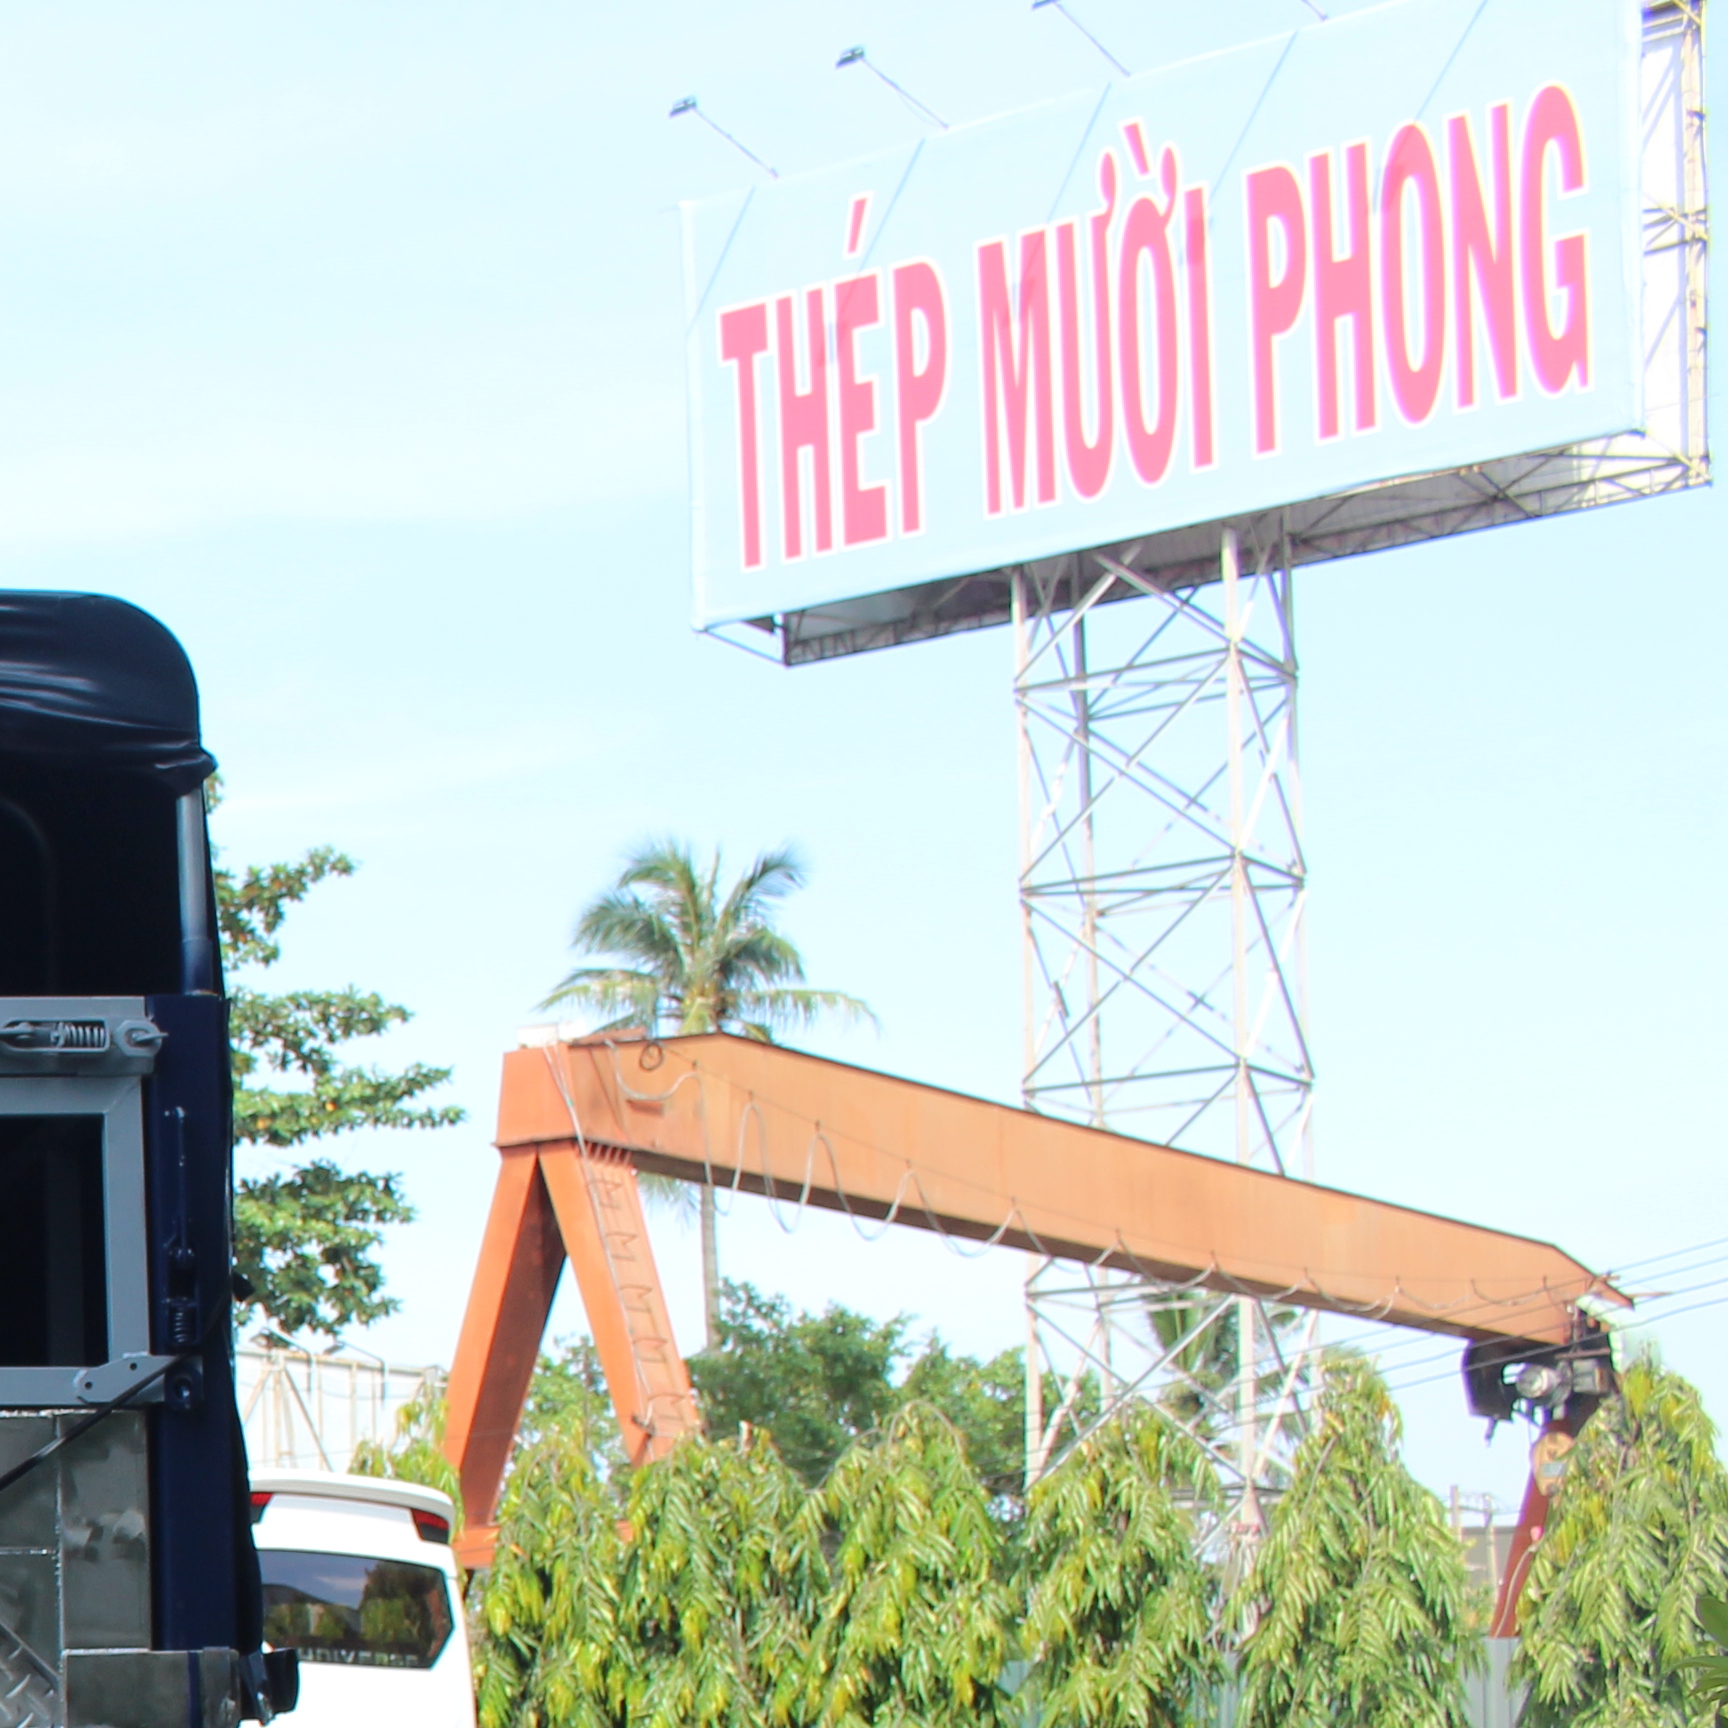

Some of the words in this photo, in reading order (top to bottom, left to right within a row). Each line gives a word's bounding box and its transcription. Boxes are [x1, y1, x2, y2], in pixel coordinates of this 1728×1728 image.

[718, 195, 947, 570] THÉP
[976, 122, 1216, 516] MƯỜI
[1246, 83, 1590, 457] PHONG
